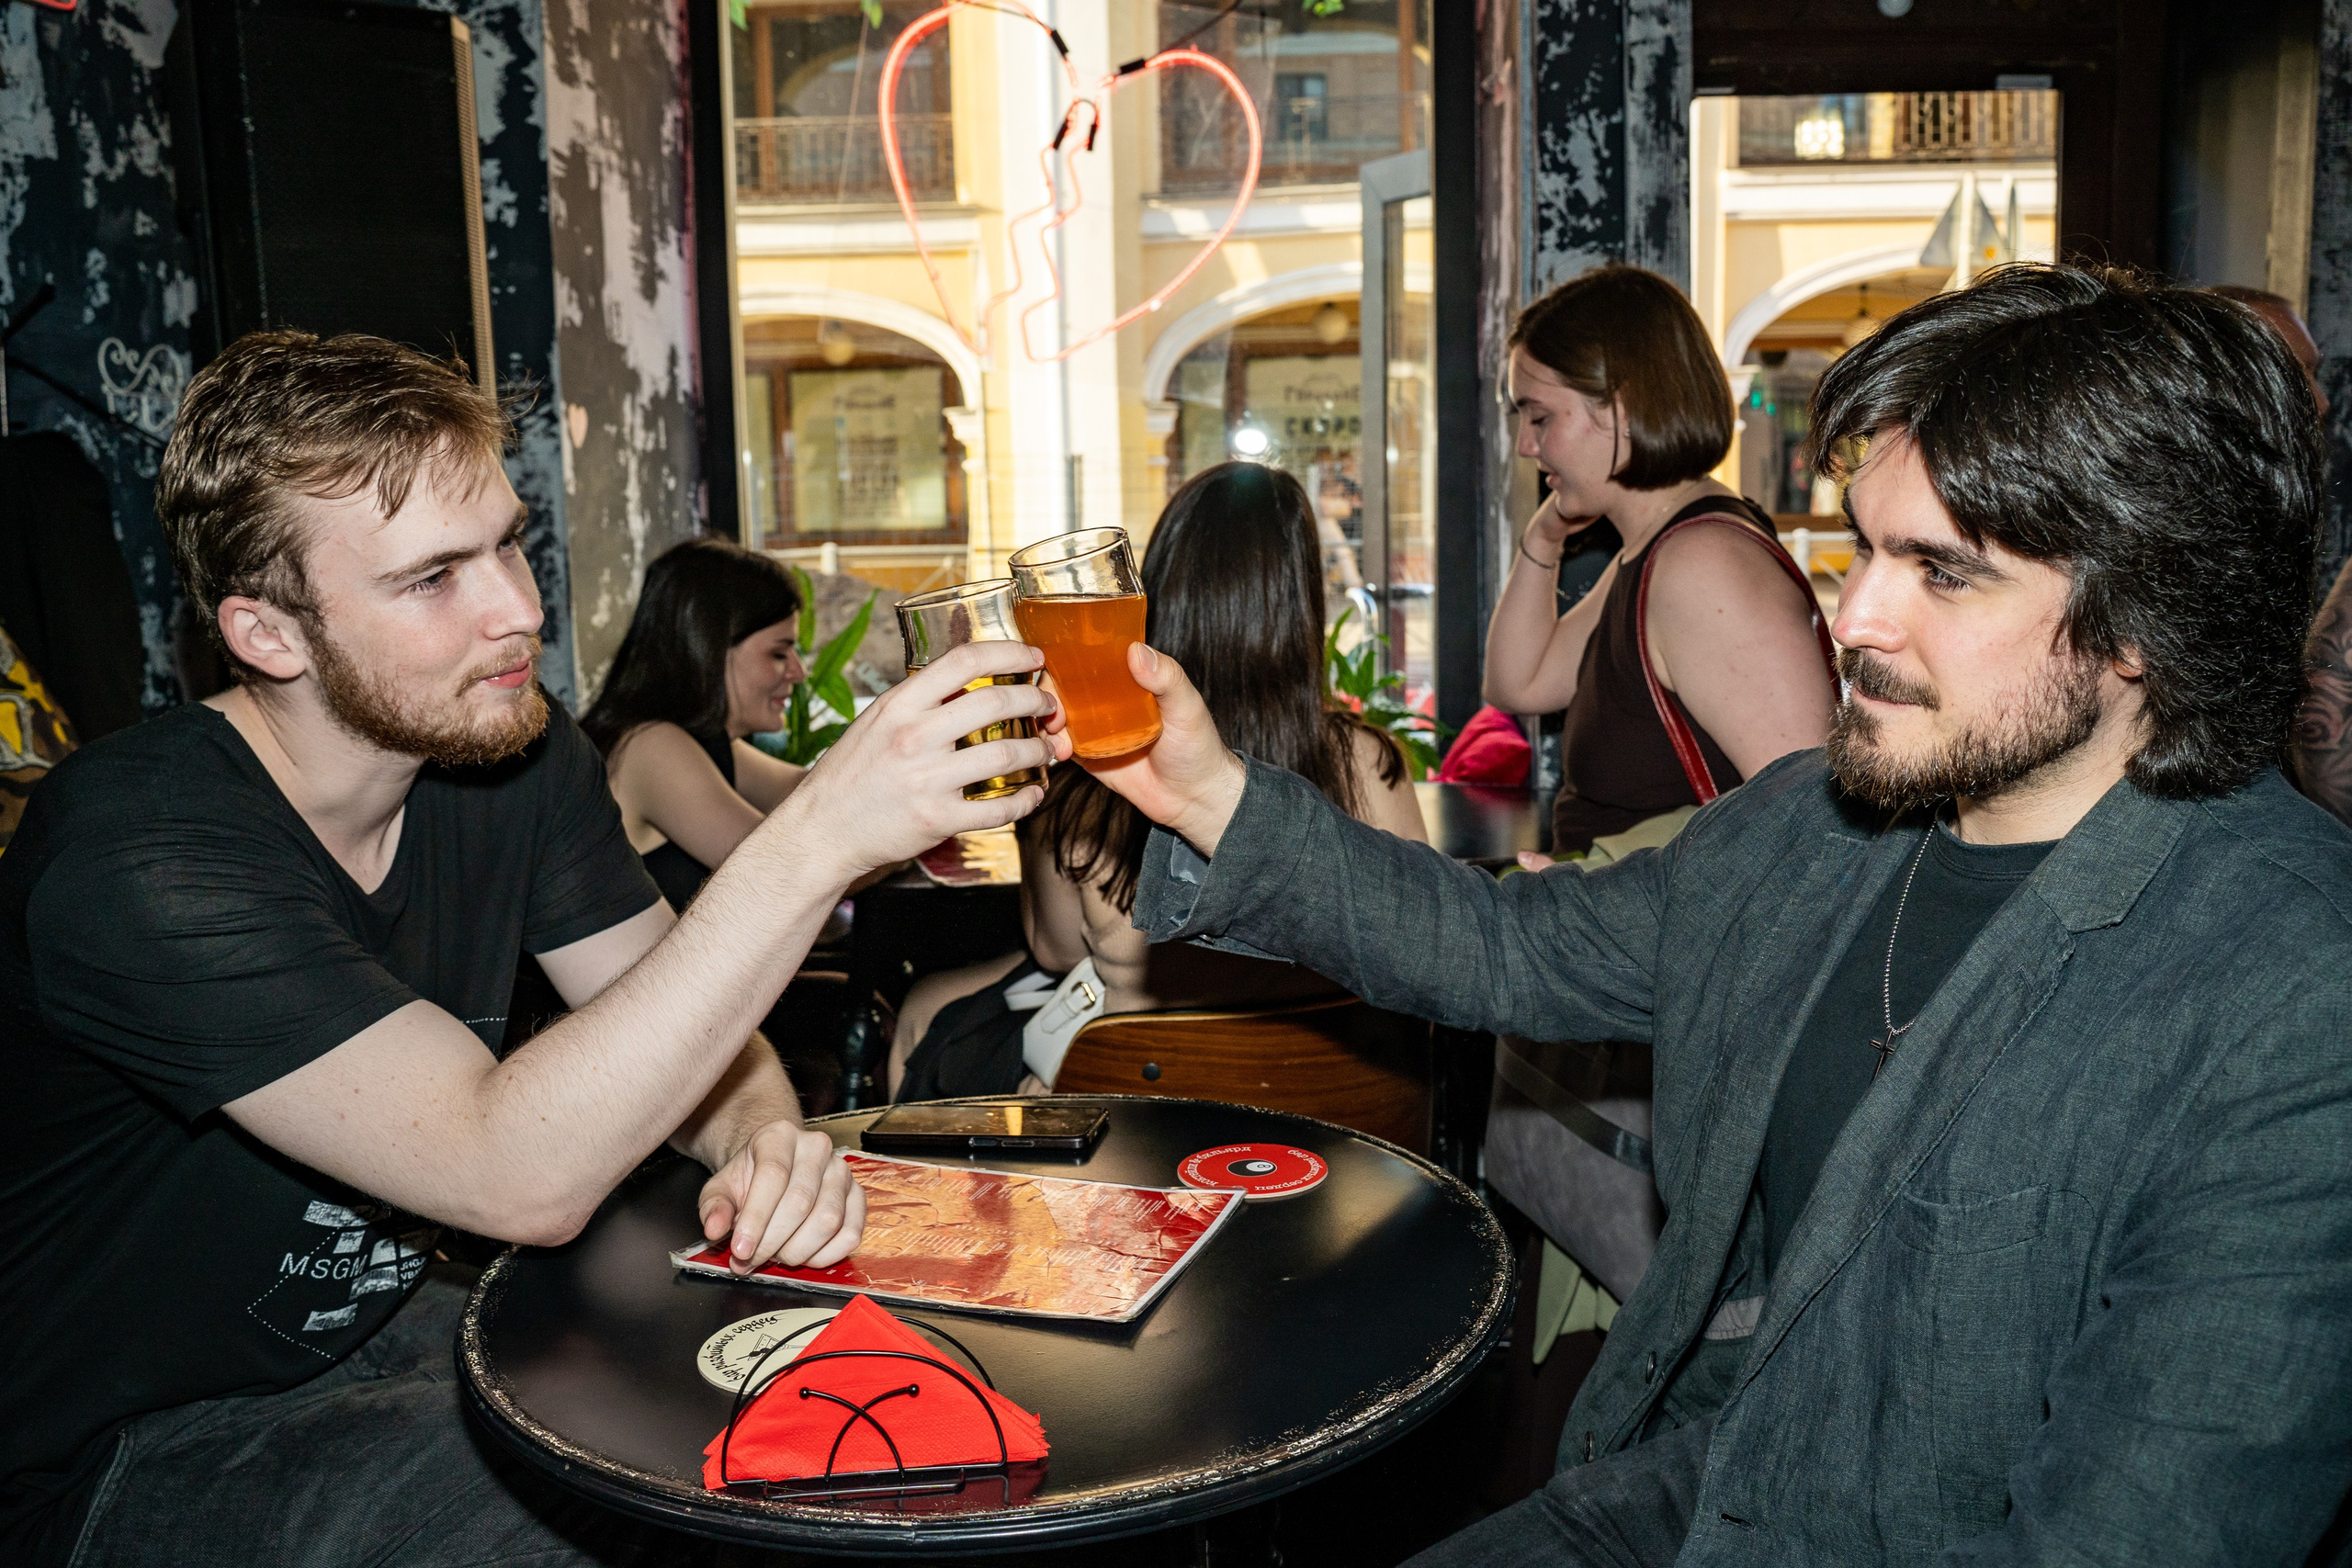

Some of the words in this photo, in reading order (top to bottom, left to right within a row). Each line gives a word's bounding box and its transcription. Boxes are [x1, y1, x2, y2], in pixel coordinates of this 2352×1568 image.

[1196, 1146, 1251, 1160] бильярд
[1287, 1149, 1309, 1161] бар
[1301, 1156, 1323, 1181] разбитых
[1255, 1179, 1303, 1190] сердец
[279, 1253, 368, 1280] MSGM
[732, 1312, 784, 1333] сердец
[701, 1334, 737, 1371] разбитых
[722, 1367, 746, 1383] бар
